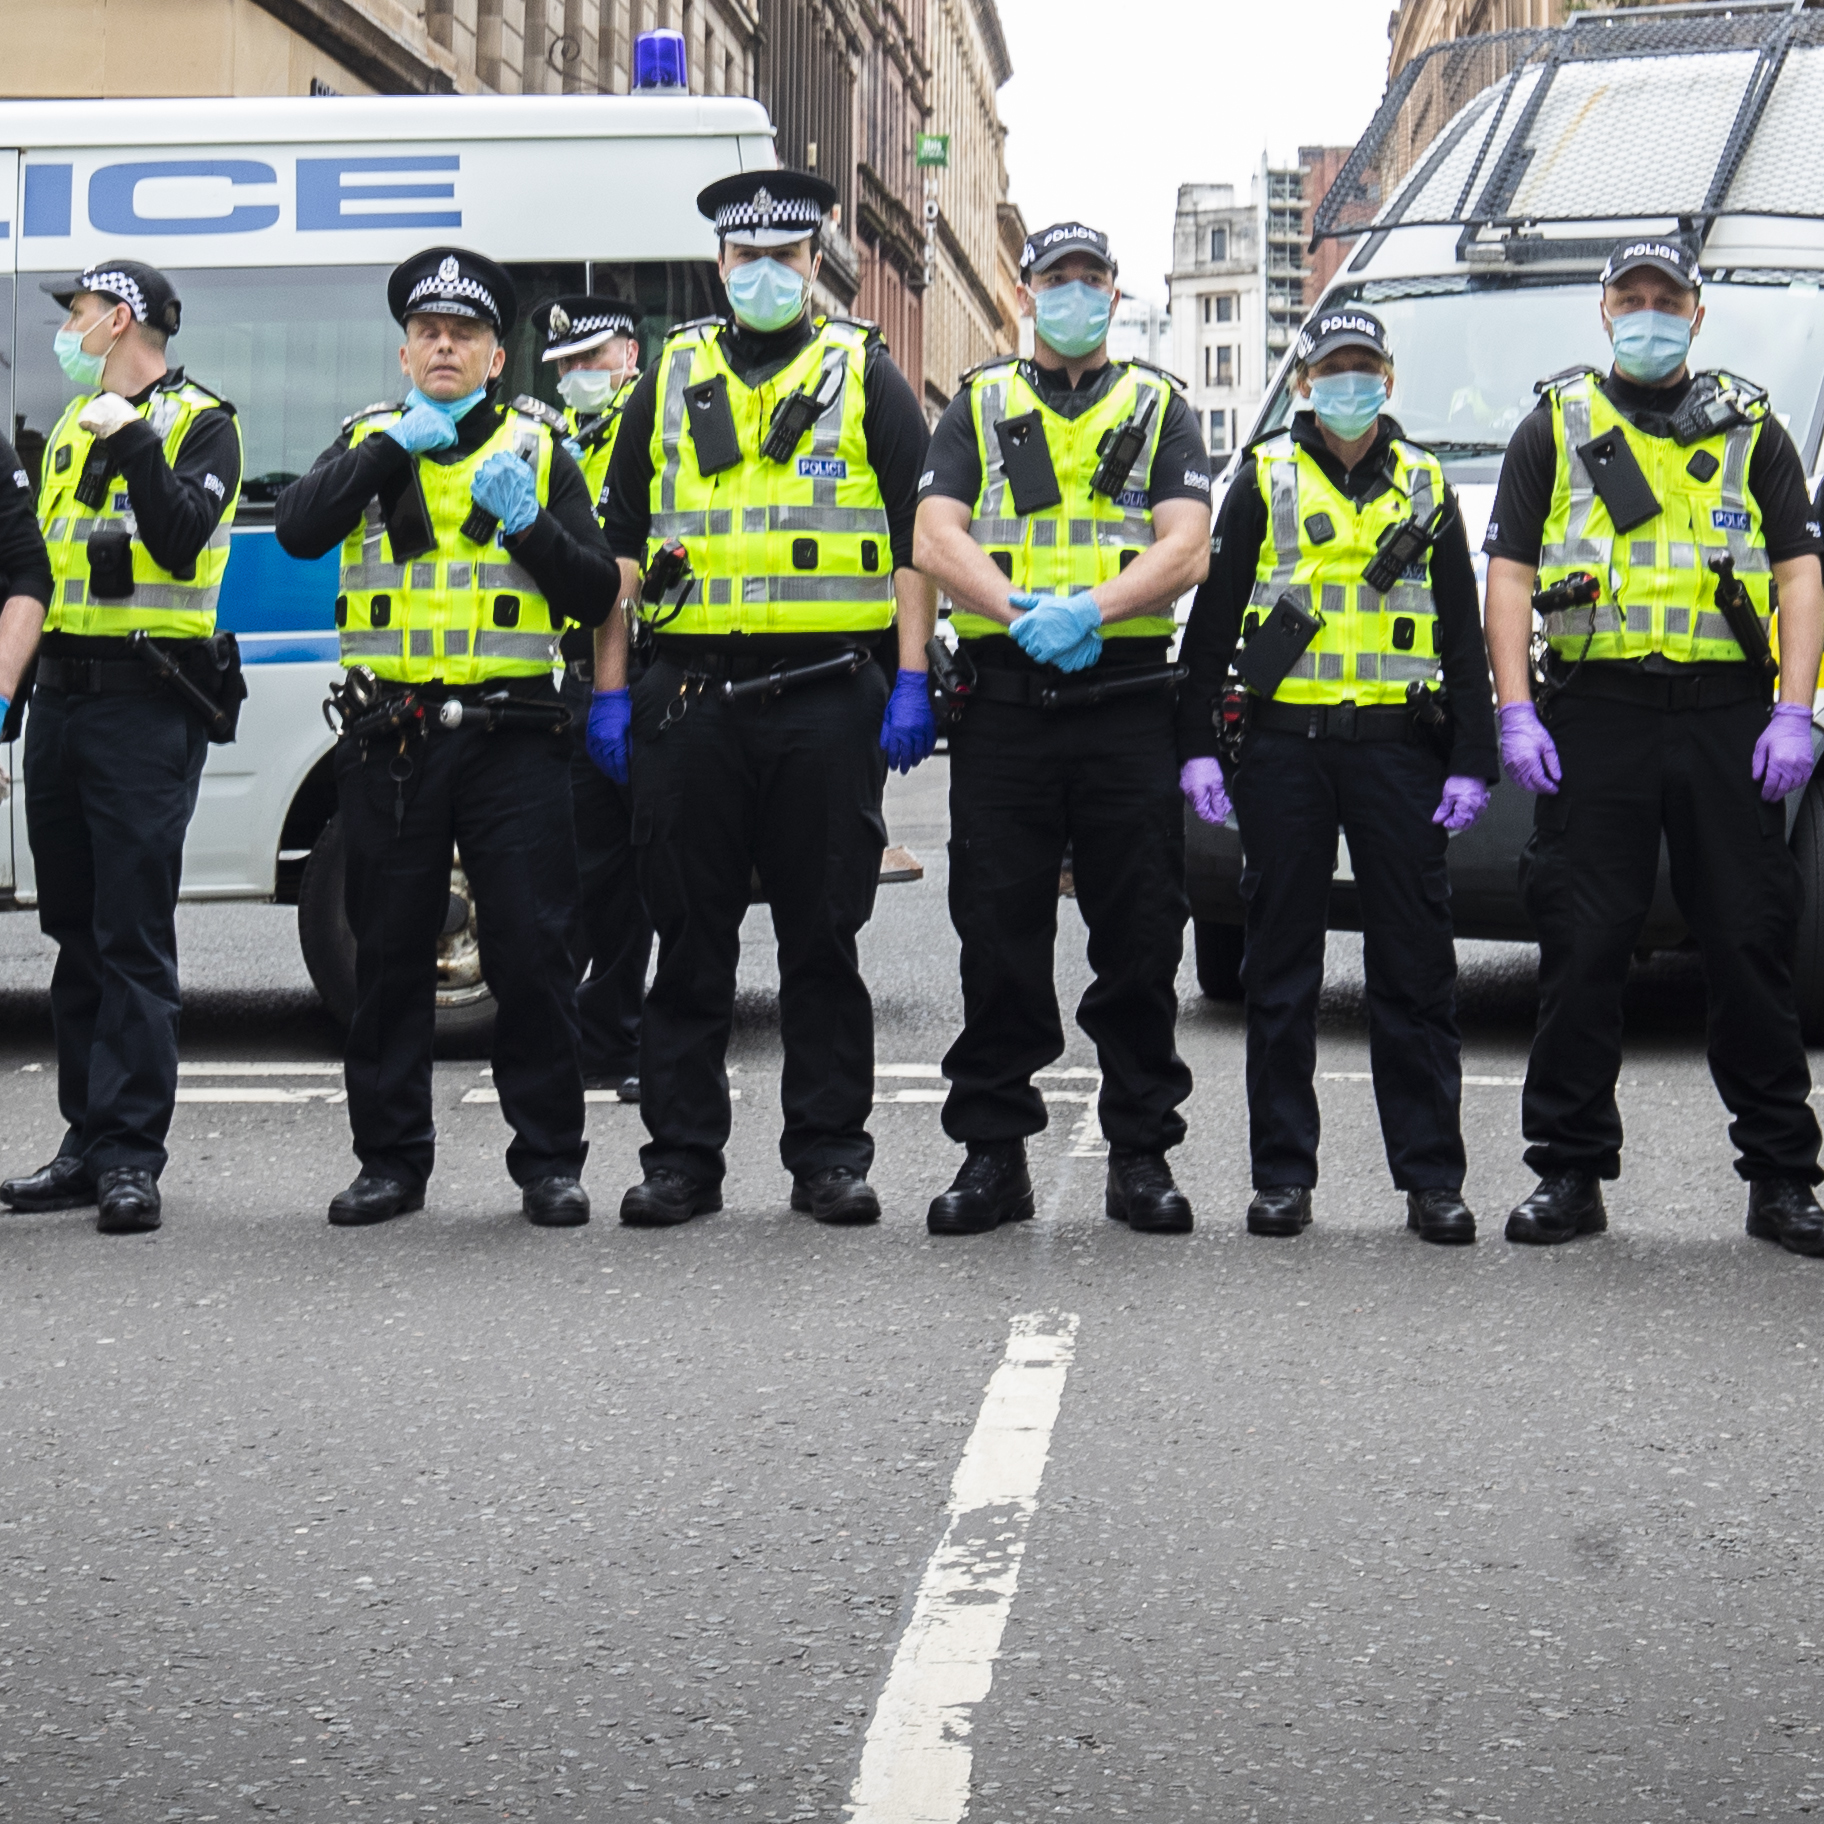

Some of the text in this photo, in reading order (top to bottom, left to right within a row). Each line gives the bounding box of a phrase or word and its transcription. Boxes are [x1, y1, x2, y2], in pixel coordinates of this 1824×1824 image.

[1044, 225, 1098, 247] POLICE
[1621, 243, 1678, 265] POLICE
[1318, 316, 1374, 337] POLICE
[801, 460, 845, 477] POLICE
